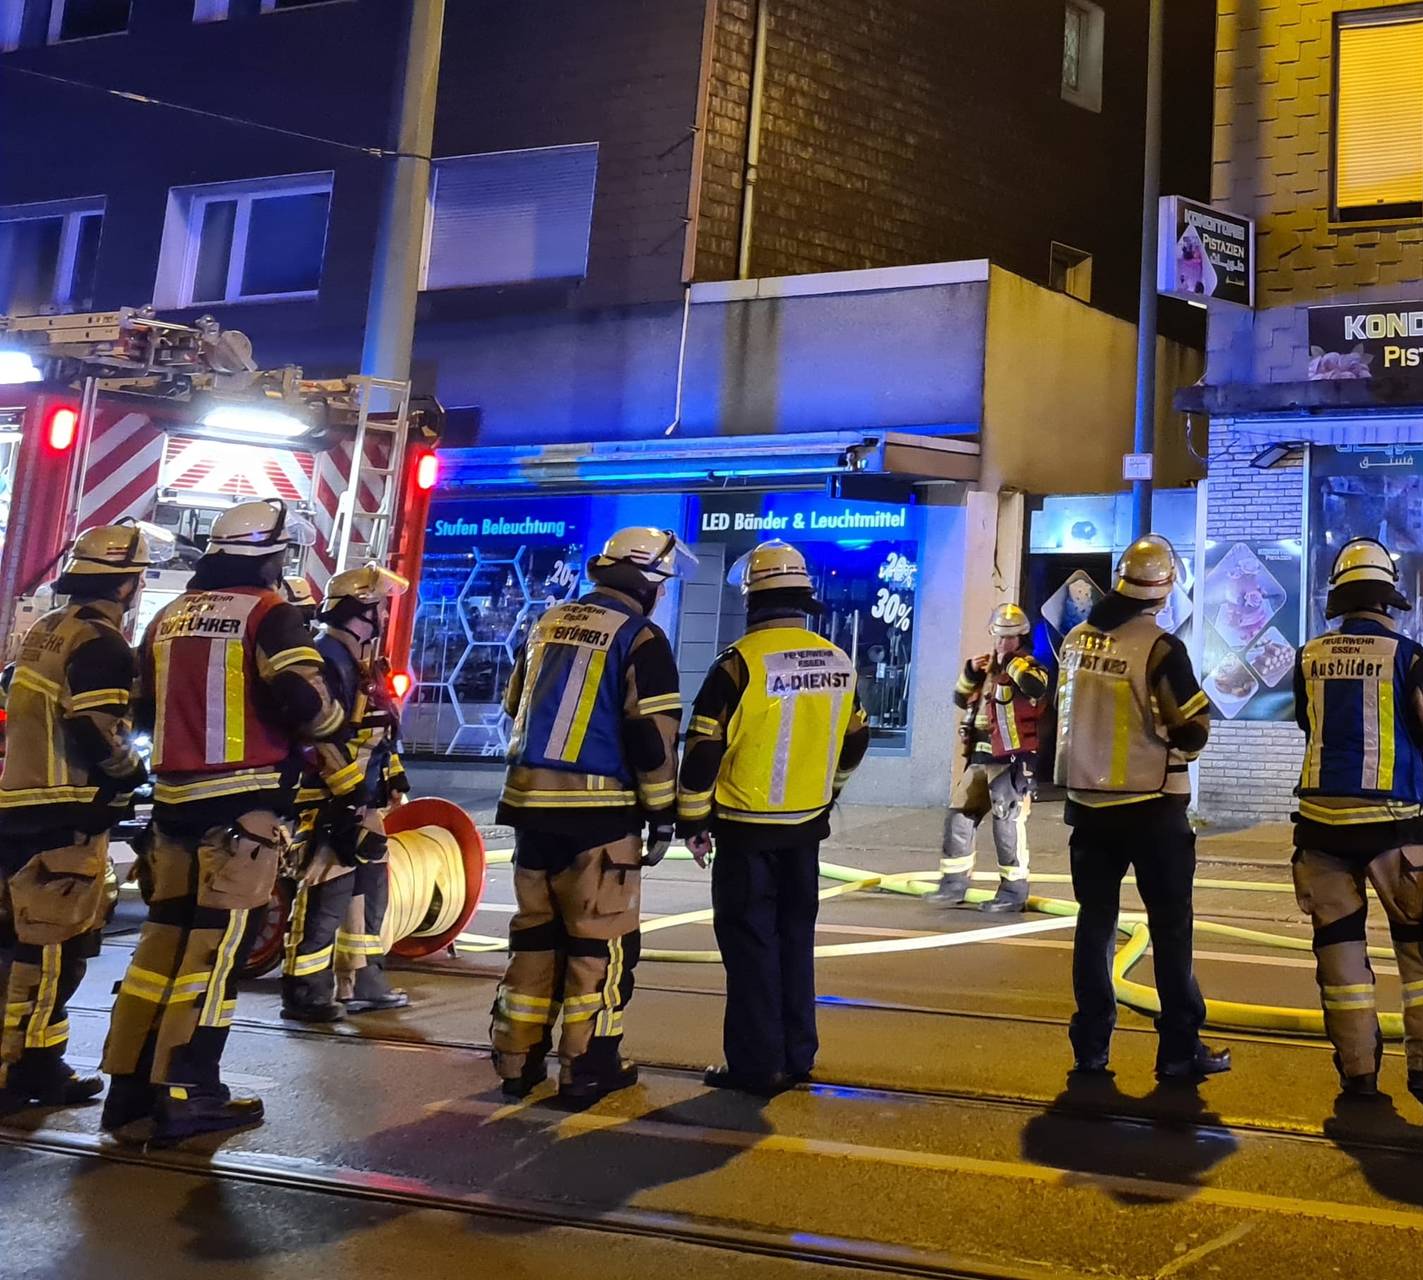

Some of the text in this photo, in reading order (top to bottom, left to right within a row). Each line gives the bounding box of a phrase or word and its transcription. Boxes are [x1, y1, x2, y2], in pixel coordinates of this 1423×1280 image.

[1202, 233, 1245, 258] PISTAZIEN
[435, 517, 565, 537] Stufen Beleuchtung
[702, 508, 906, 531] LED Bänder & Leuchtmittel
[871, 587, 913, 631] 30%
[600, 632, 610, 646] 3
[1321, 637, 1375, 646] FEUERWEHR
[1331, 646, 1361, 655] ESSEN
[1310, 659, 1383, 679] Ausbilder
[773, 672, 850, 692] A-DIENST
